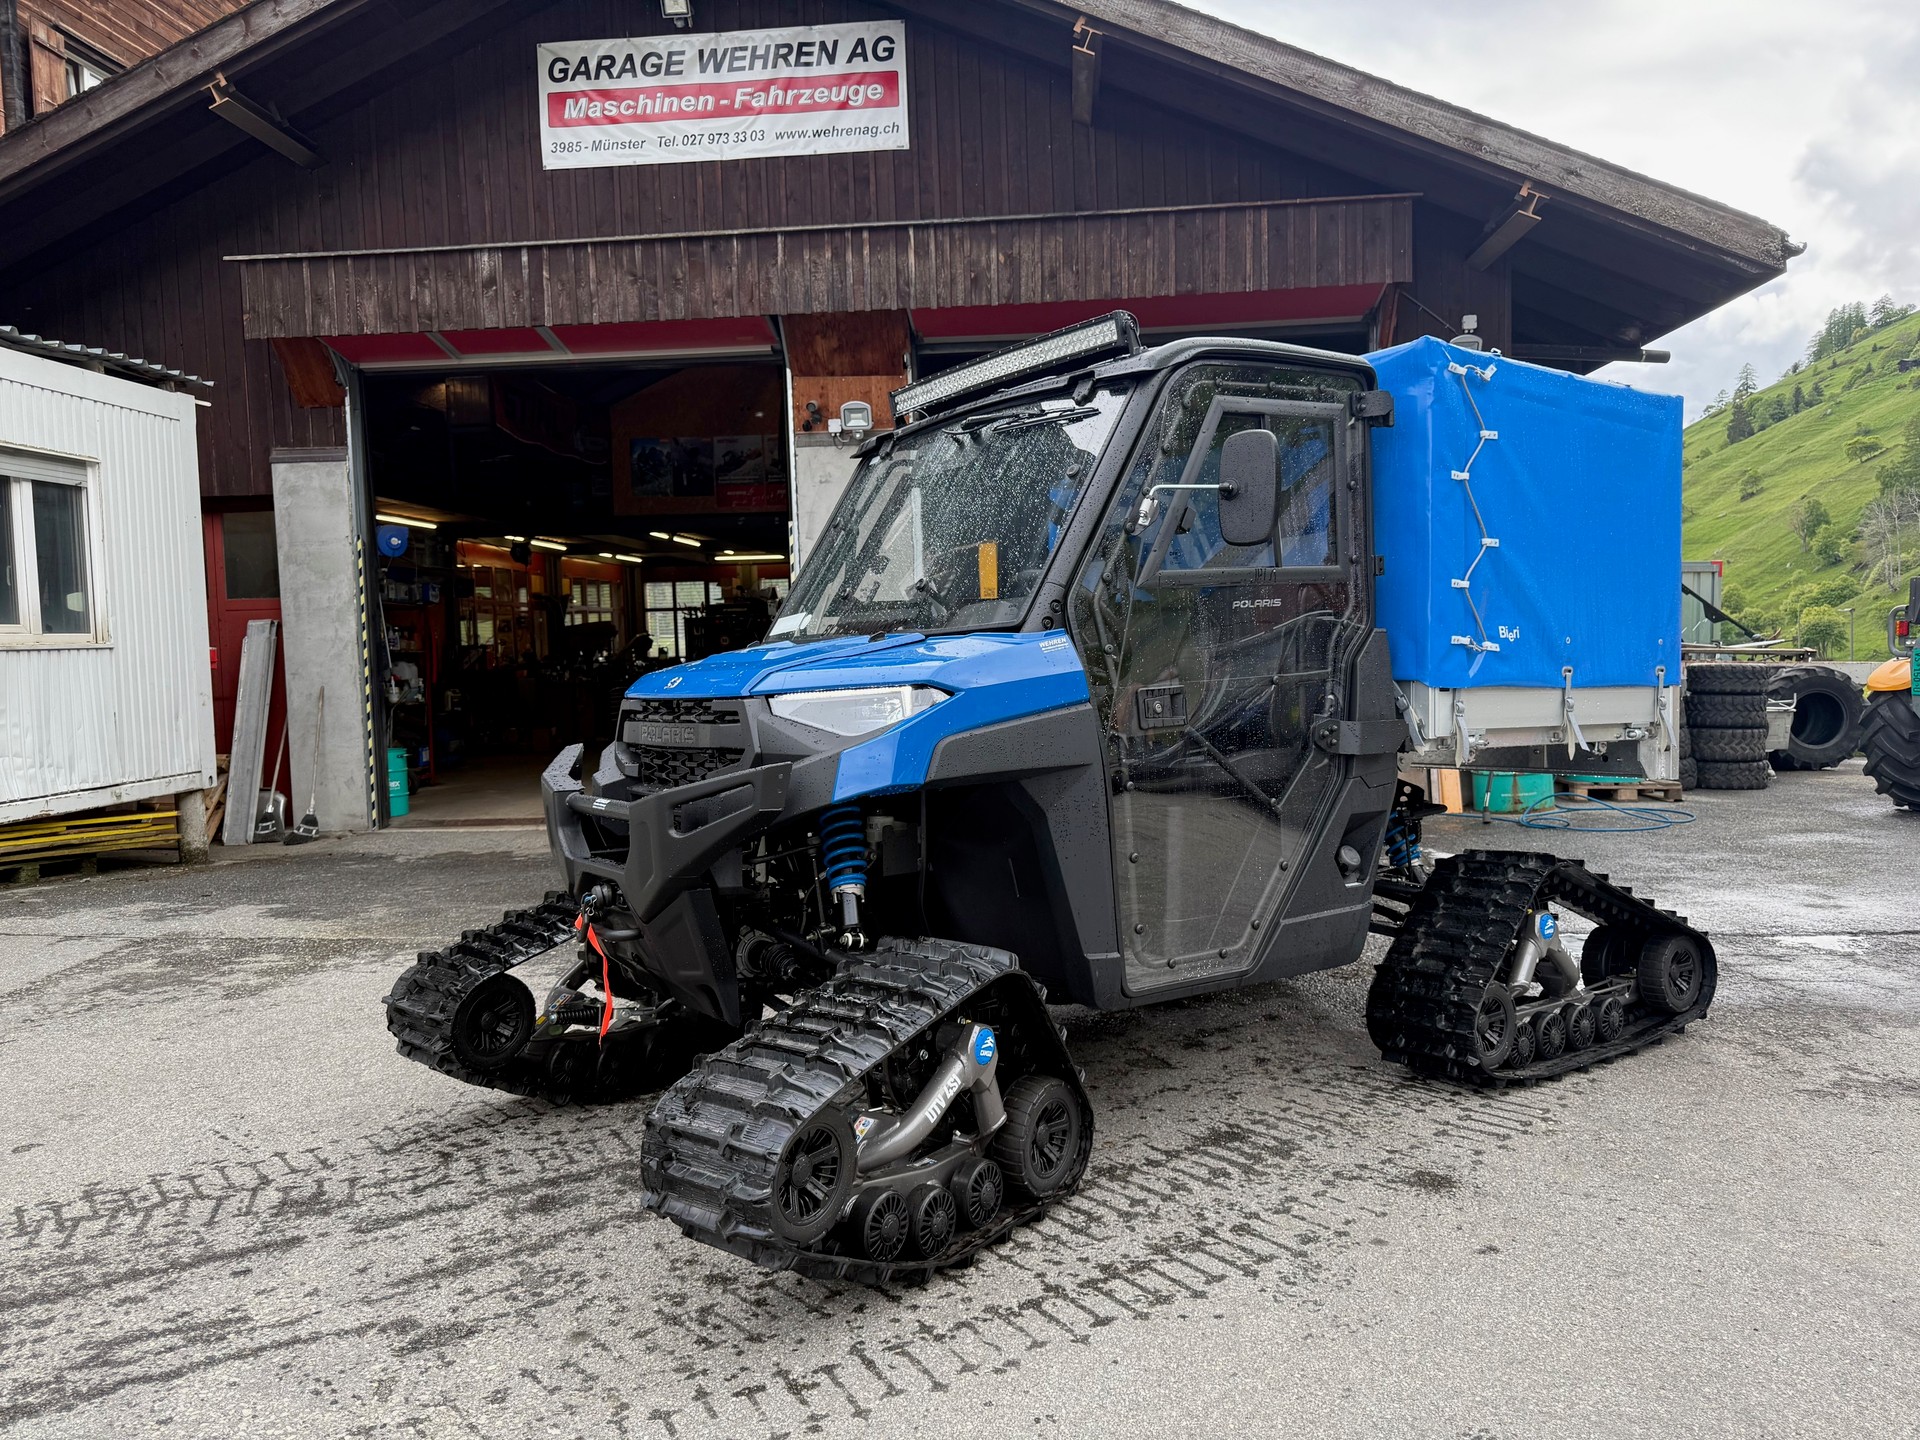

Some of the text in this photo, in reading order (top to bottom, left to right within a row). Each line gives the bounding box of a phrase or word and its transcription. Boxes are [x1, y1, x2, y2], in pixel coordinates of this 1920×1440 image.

[547, 35, 896, 83] GARAGE WEHREN AG
[564, 92, 715, 119] Maschinen
[734, 83, 884, 109] Fahrzeuge
[657, 136, 679, 148] Tel.
[681, 134, 704, 146] 027
[707, 132, 730, 145] 973
[732, 131, 748, 143] 33
[750, 129, 766, 142] 03
[775, 121, 900, 140] www.wehrenag.ch
[1232, 598, 1282, 609] POLARIS
[1039, 637, 1067, 648] WEHREN
[1498, 625, 1520, 642] Bieri
[641, 724, 695, 744] POLARIS
[925, 1094, 946, 1123] UTV
